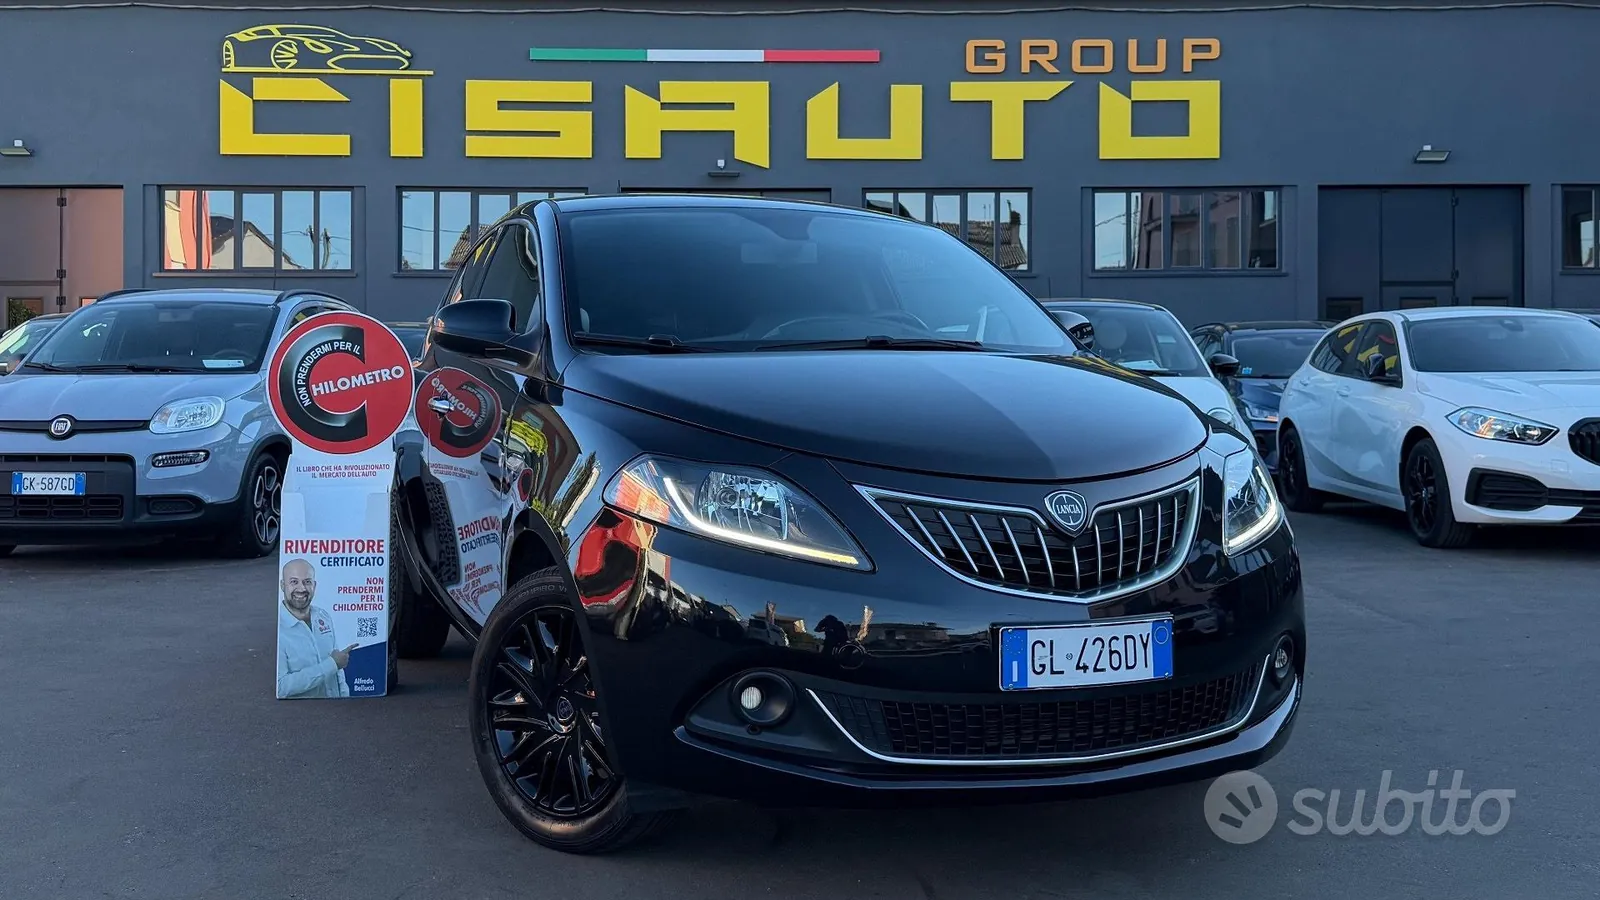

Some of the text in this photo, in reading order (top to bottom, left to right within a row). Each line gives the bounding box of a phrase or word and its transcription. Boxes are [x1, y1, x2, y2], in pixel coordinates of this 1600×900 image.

[965, 38, 1221, 74] GROUP
[219, 77, 1221, 169] CISAUTO
[297, 341, 361, 408] NON PRENDERMI PER IL
[1056, 504, 1081, 514] LANCIA
[284, 539, 385, 554] RIVENDITORE
[320, 556, 385, 567] CERTIFICATO
[366, 577, 384, 585] NON
[337, 586, 384, 594] PRENDERMI
[360, 594, 385, 603] PER IL
[332, 603, 384, 612] CHILOMETRO
[353, 677, 374, 685] Alfredo
[353, 684, 375, 692] Bellucci
